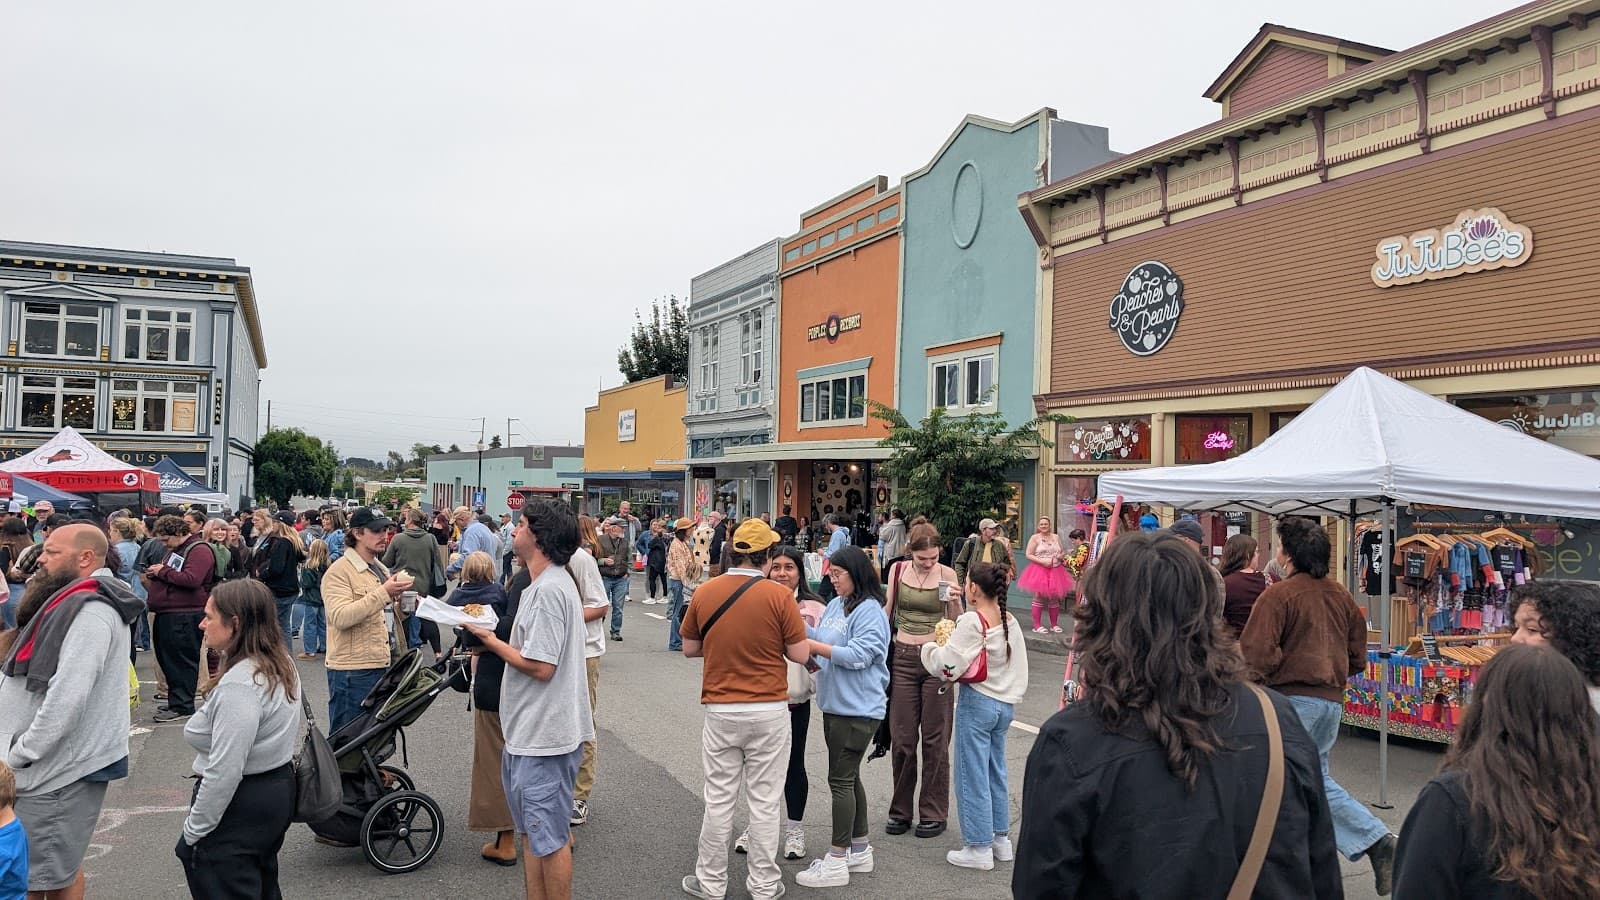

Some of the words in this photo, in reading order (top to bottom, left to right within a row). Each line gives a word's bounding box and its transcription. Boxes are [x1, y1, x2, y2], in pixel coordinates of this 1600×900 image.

[1376, 231, 1524, 280] JuJuBee's
[1110, 277, 1164, 328] Peaches
[1120, 313, 1132, 332] &
[1132, 294, 1180, 344] Pearls
[57, 476, 121, 485] LOBSTER
[508, 498, 524, 506] STOP
